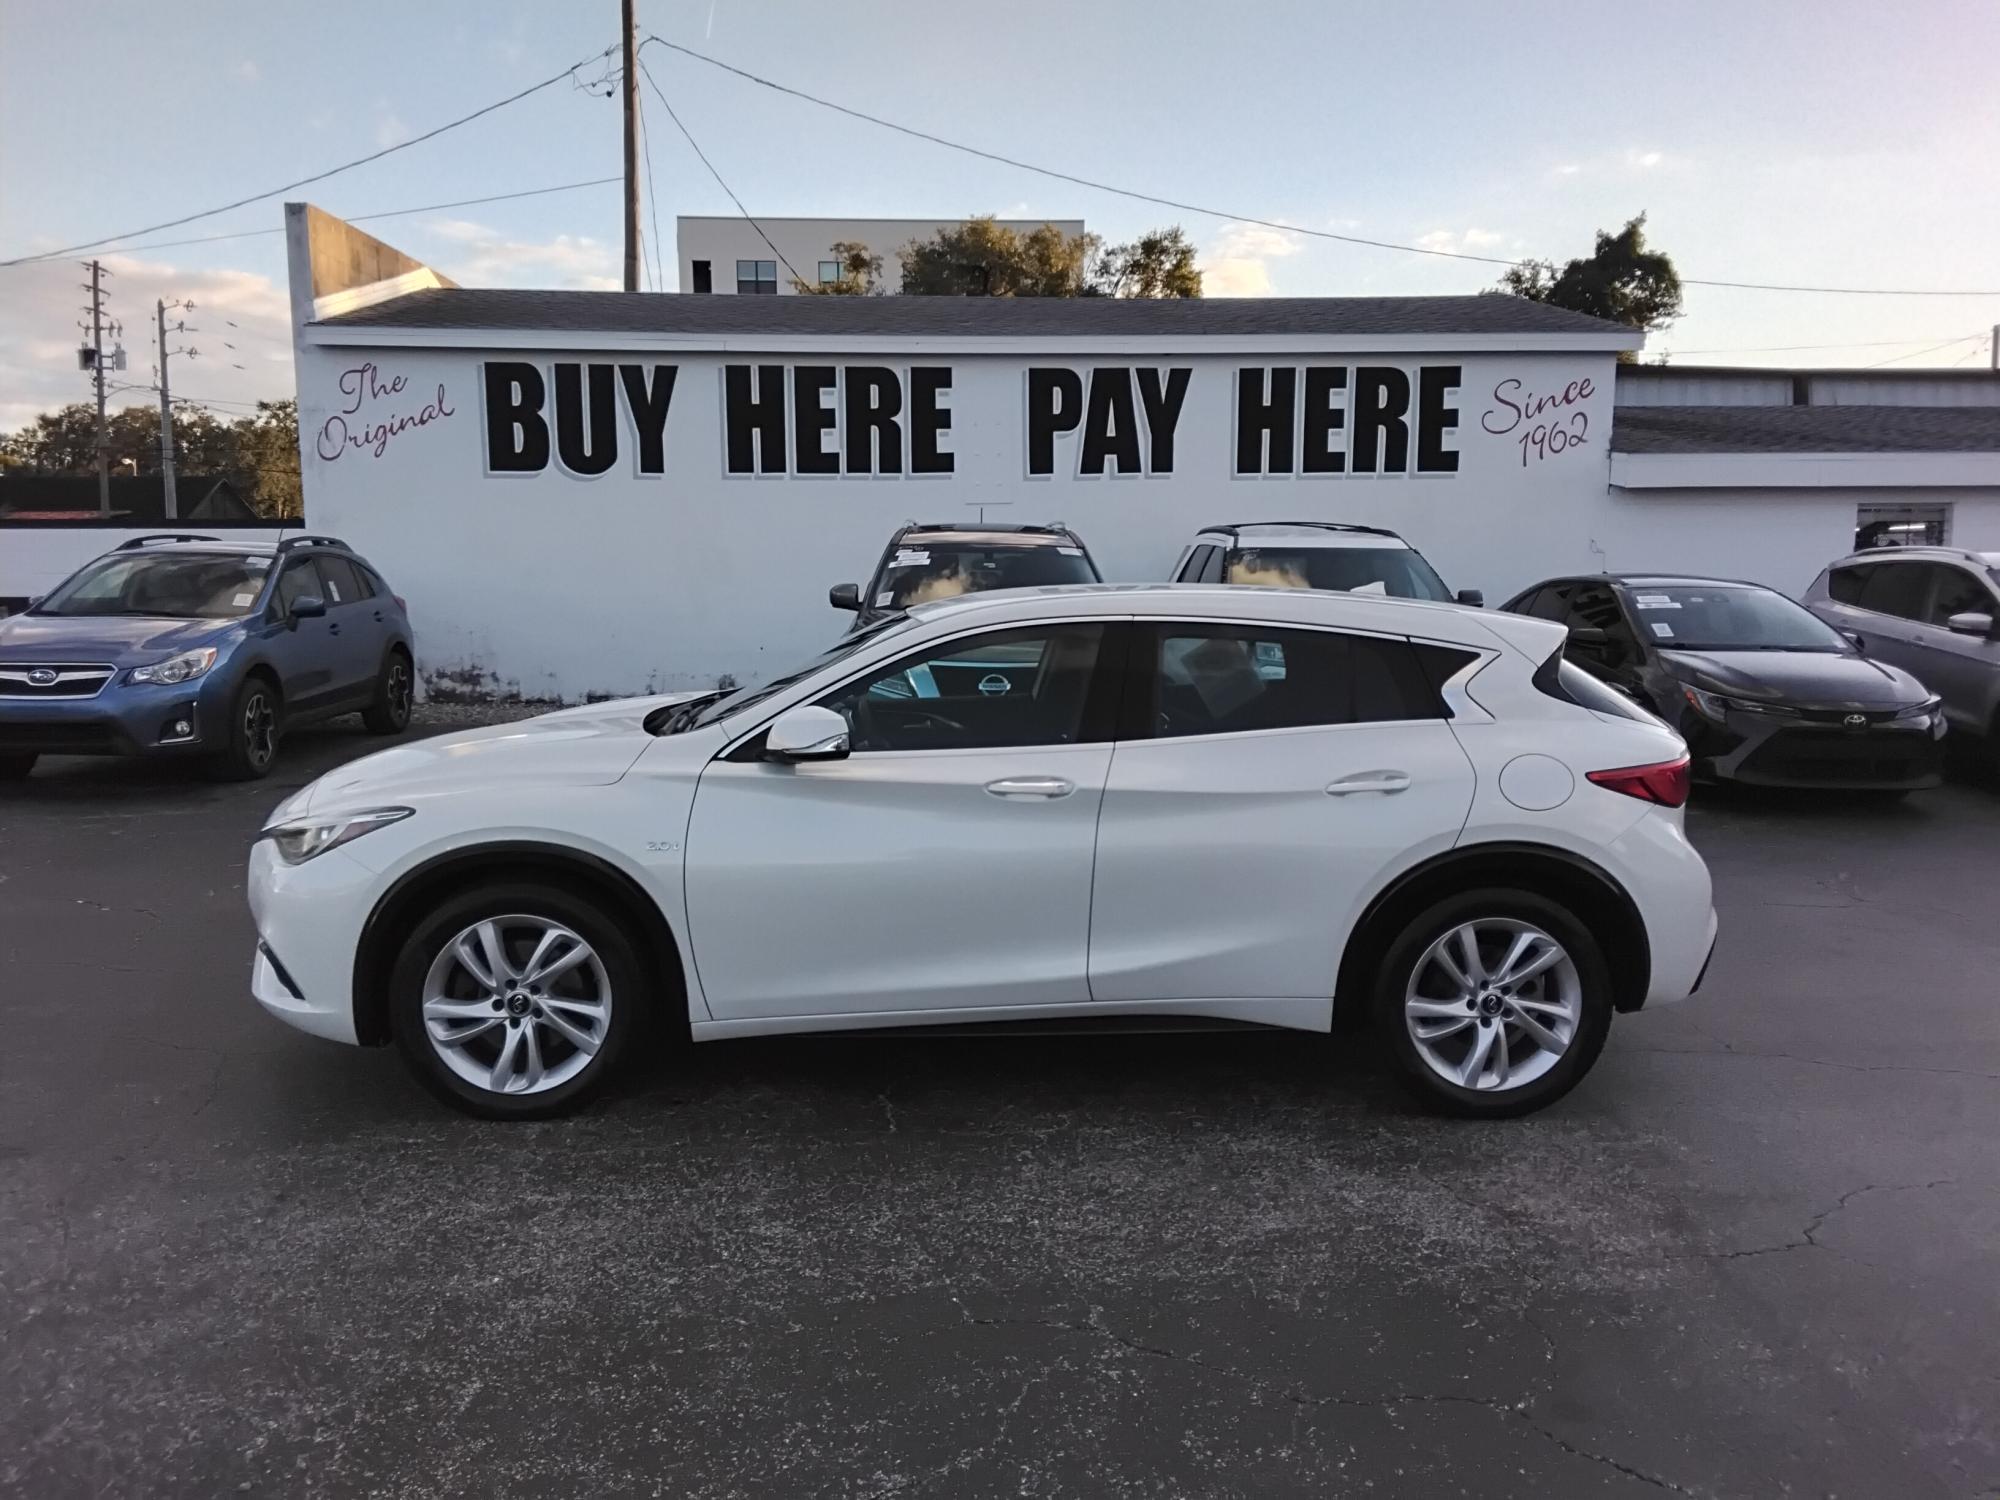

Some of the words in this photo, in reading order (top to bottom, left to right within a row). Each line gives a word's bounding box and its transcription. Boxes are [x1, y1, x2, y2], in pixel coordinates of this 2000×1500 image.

[339, 362, 408, 414] The
[1481, 378, 1596, 435] Since
[317, 383, 456, 462] Original
[483, 361, 679, 476] BUY
[724, 364, 955, 475] HERE
[1028, 367, 1193, 476] PAY
[1236, 364, 1462, 475] HERE
[1518, 411, 1589, 468] 1962
